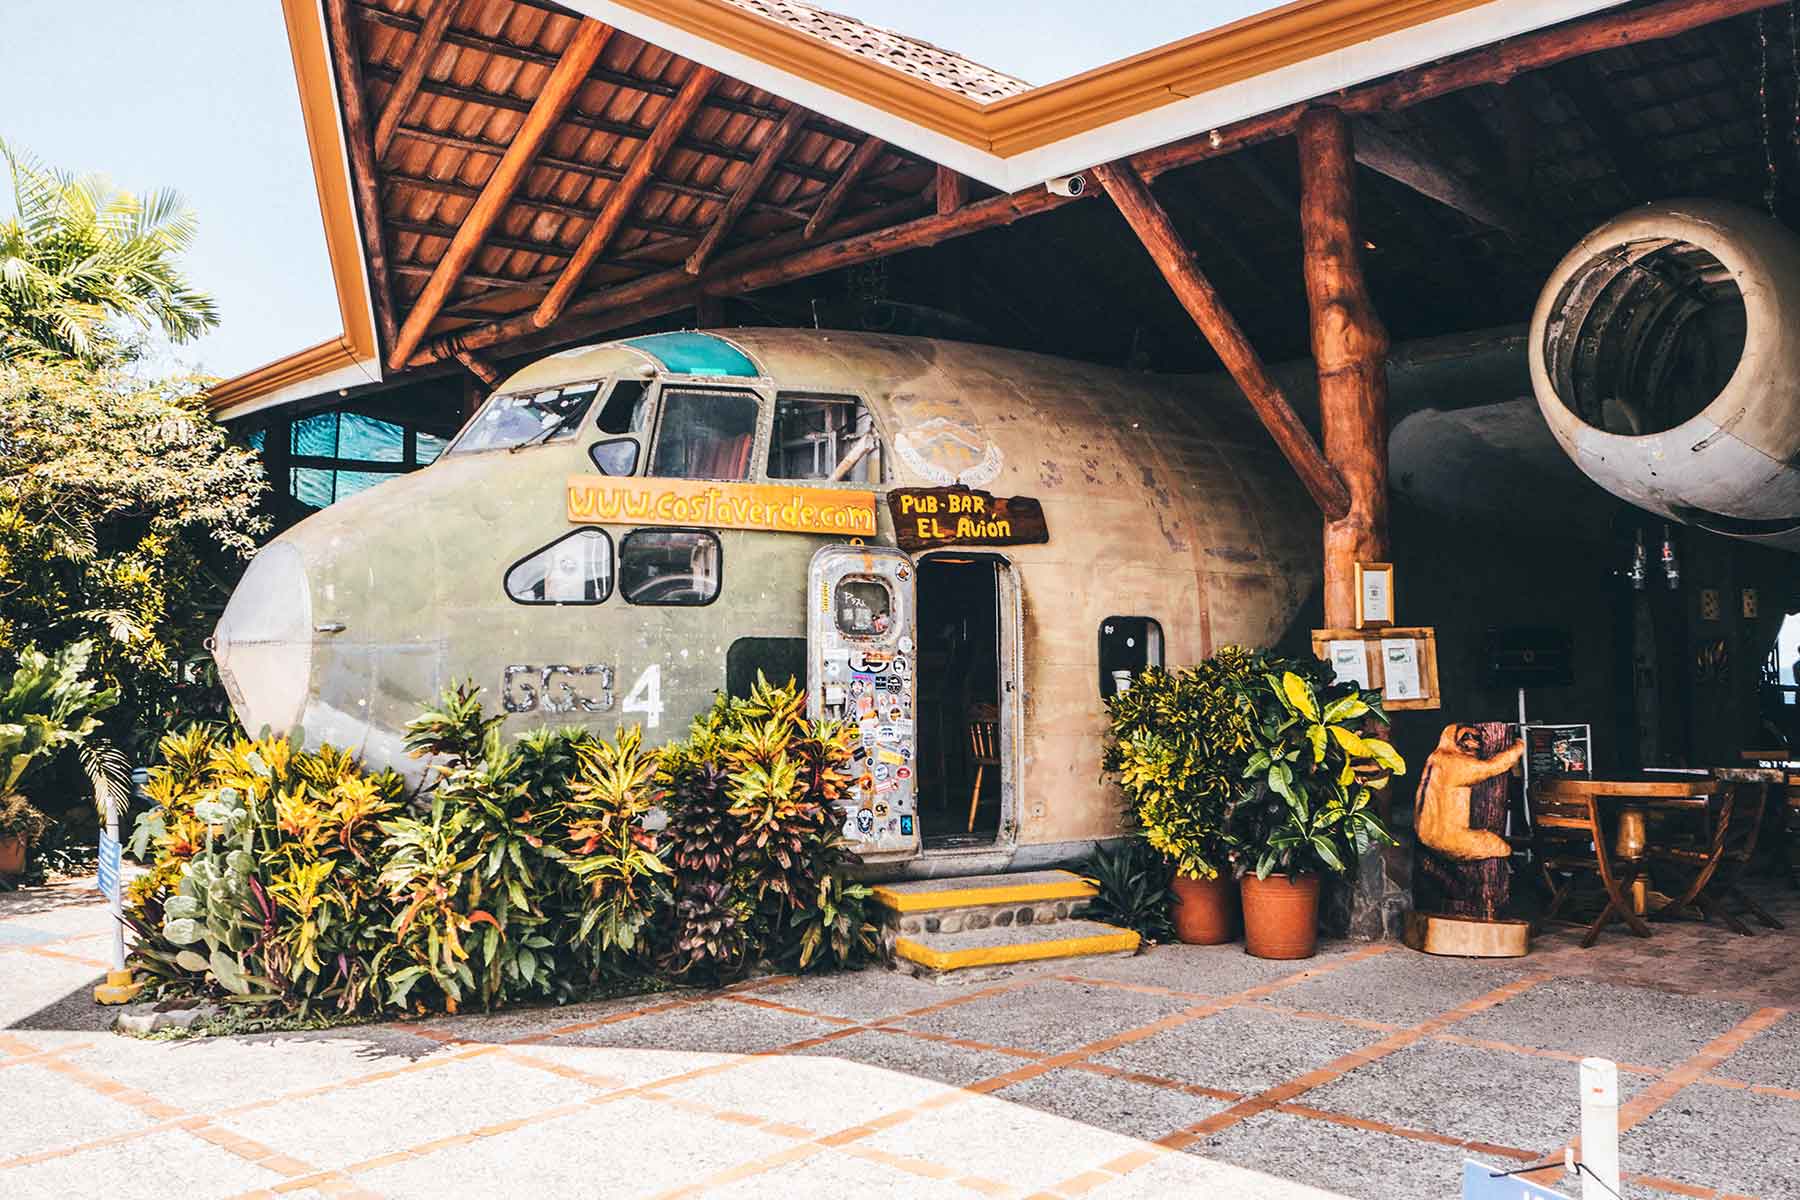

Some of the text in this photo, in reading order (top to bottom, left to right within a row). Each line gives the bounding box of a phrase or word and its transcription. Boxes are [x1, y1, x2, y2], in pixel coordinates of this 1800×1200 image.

[917, 513, 1011, 538] EL Avión
[622, 663, 665, 729] 4
